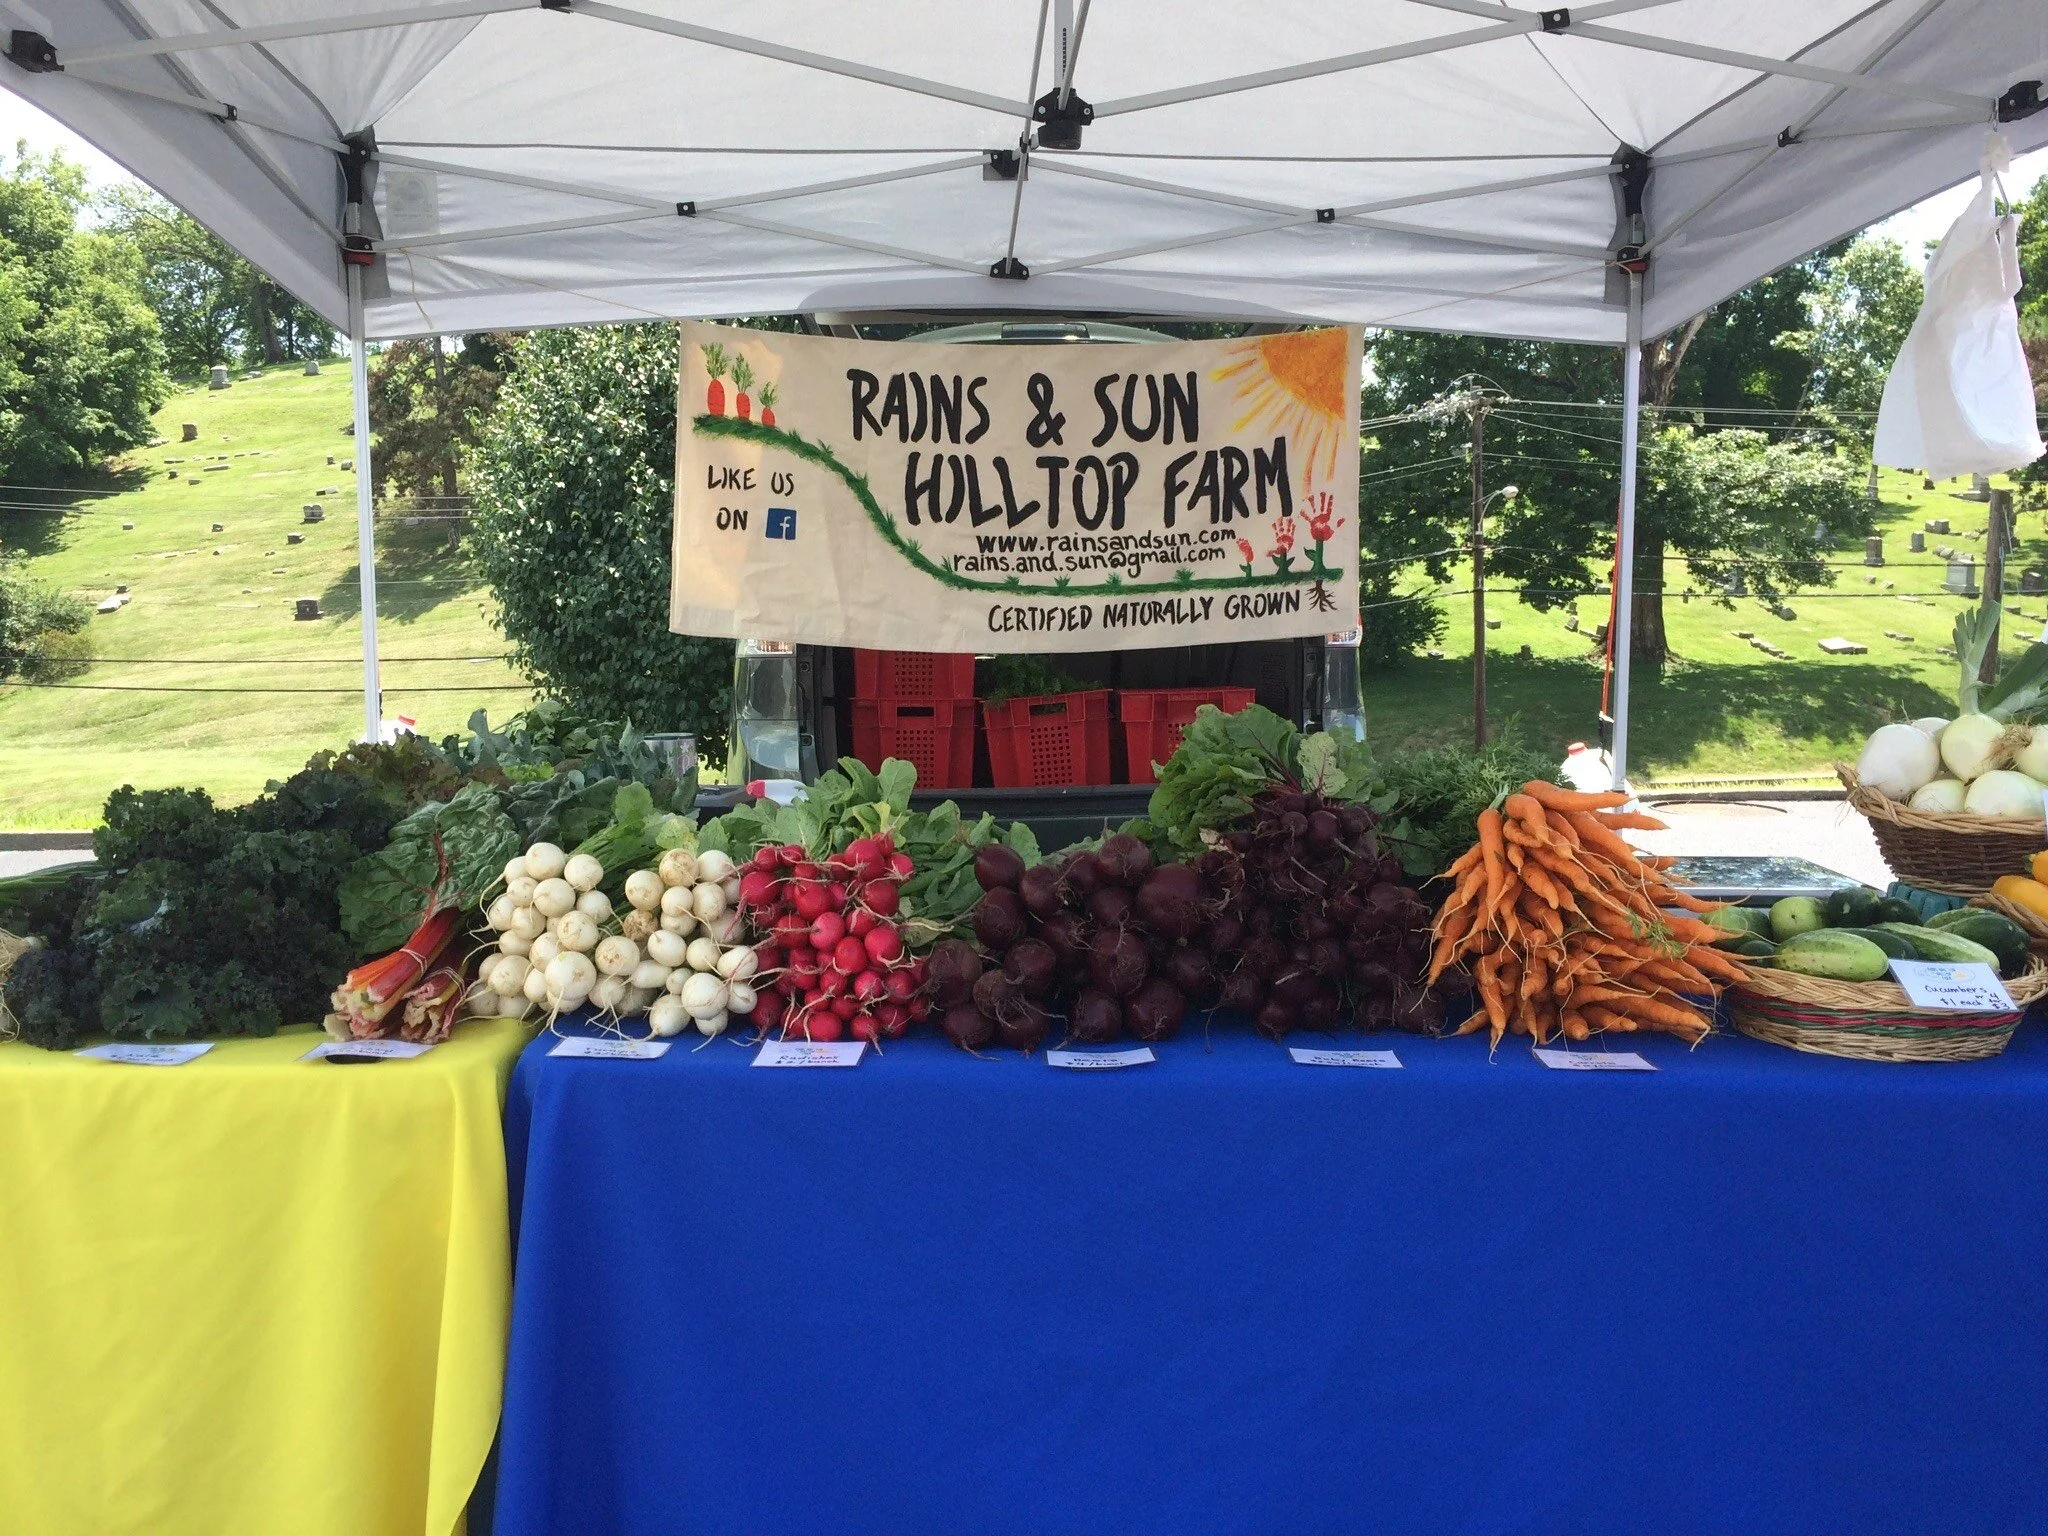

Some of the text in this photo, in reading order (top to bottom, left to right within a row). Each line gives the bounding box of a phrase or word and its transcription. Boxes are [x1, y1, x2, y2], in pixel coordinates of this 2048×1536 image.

[846, 368, 1199, 449] RAINS & SUN
[707, 464, 795, 498] LIKE US
[904, 436, 1293, 532] HILLTOP FARM
[716, 506, 749, 531] ON
[975, 528, 1238, 554] www.rainsandsun.com
[953, 545, 1227, 579] rains.and.sun@gmail.com
[987, 589, 1301, 633] CERTIFIED NATURALLY GROWN
